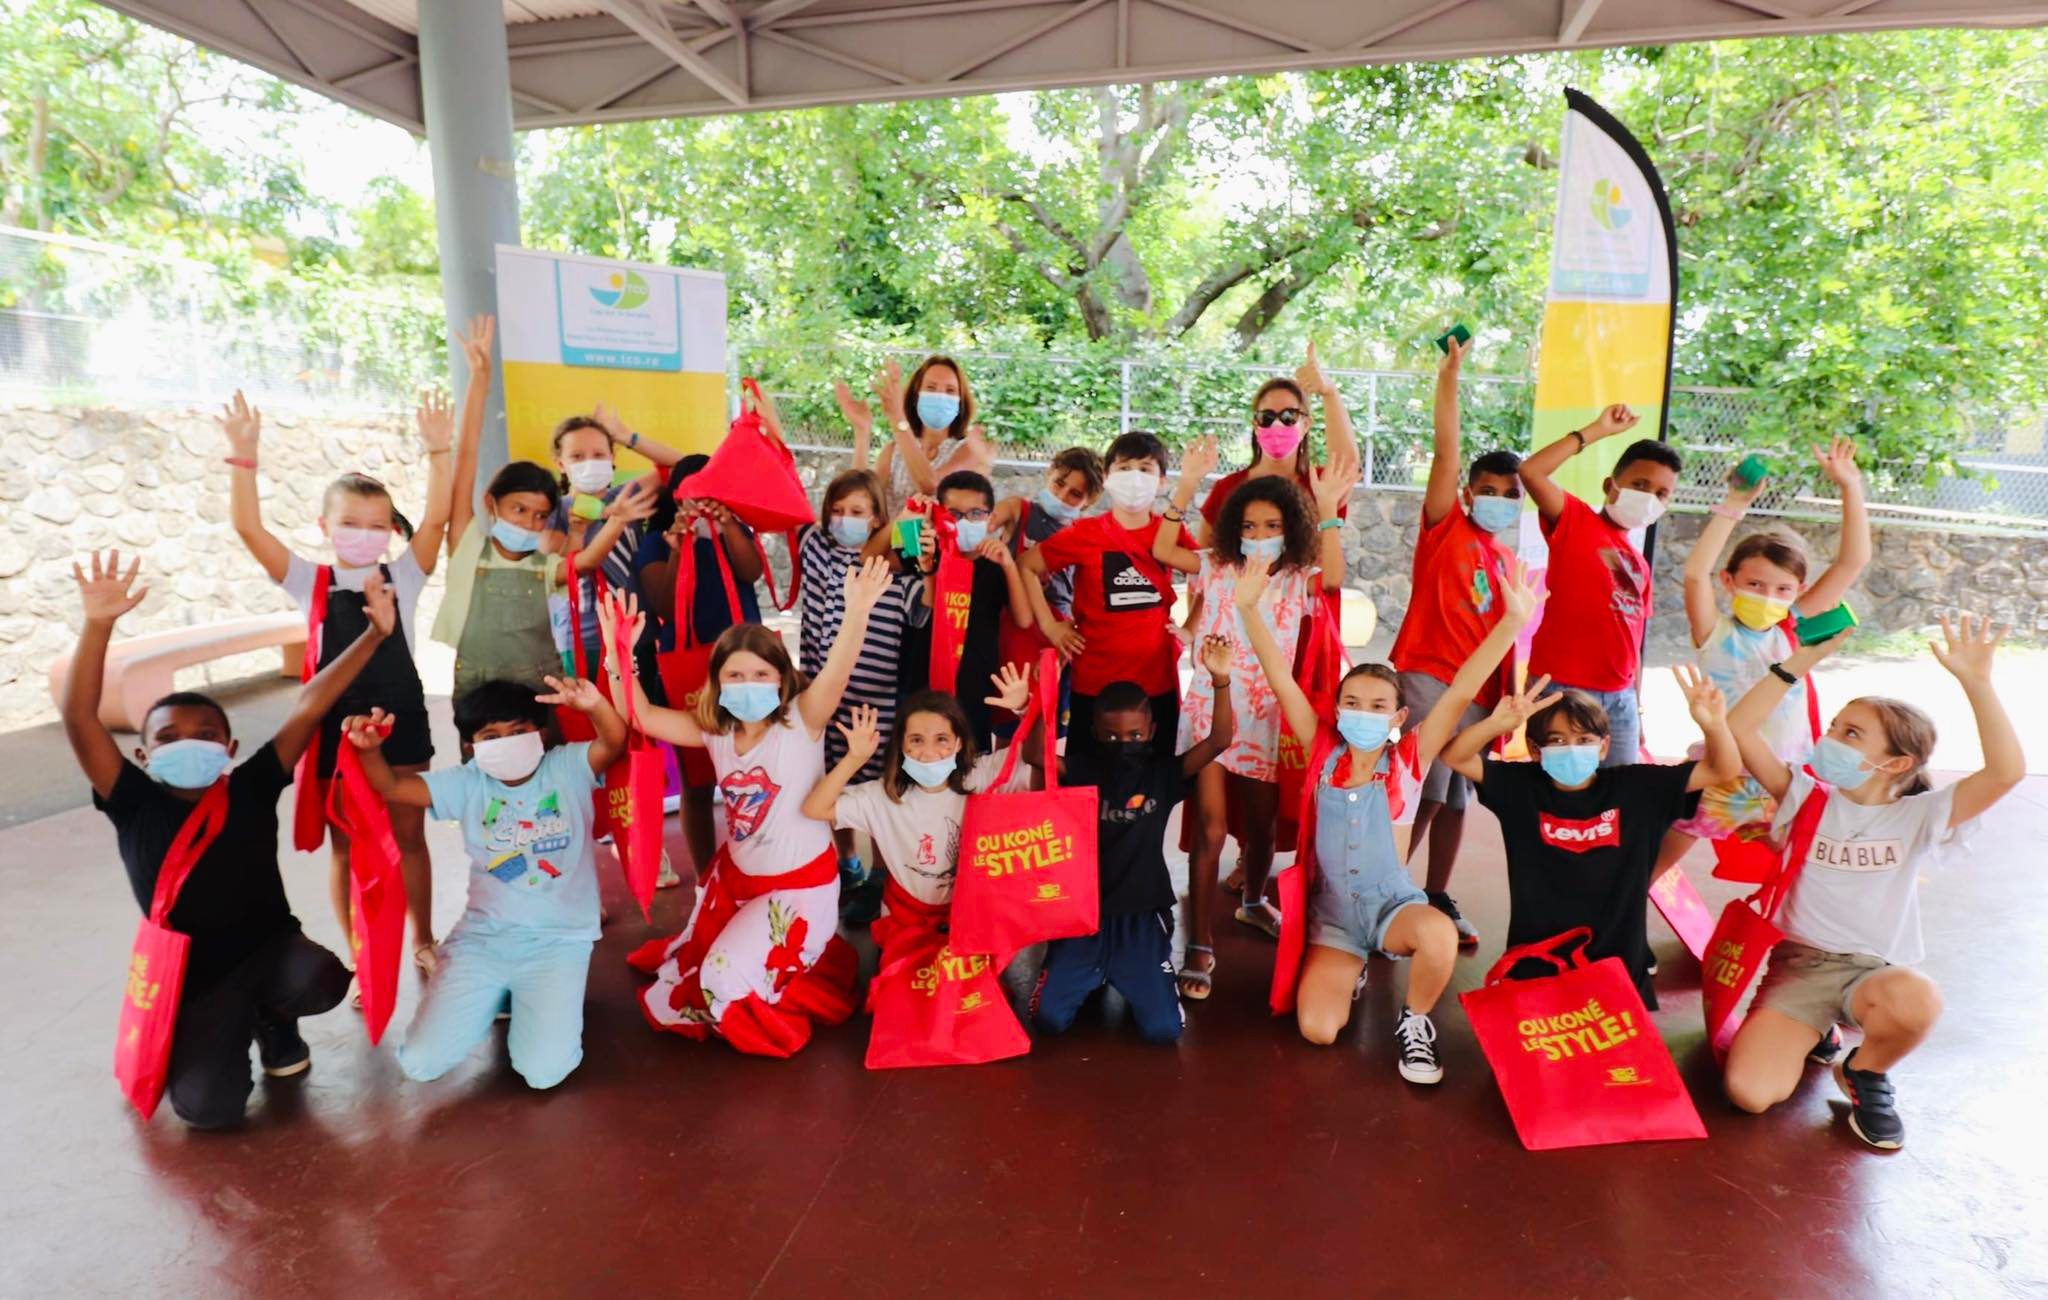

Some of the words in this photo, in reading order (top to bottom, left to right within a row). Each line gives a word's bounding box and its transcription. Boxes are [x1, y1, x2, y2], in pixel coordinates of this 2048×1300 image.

[976, 834, 1001, 852] OU
[1003, 818, 1056, 849] KONÉ
[1815, 841, 1852, 866] BLA
[1857, 846, 1897, 866] BLA
[973, 854, 986, 867] LE
[986, 835, 1073, 877] STYLE!
[1518, 1018, 1549, 1036] OU
[1547, 997, 1606, 1032] KONÉ
[1540, 1010, 1638, 1061] STYLE!
